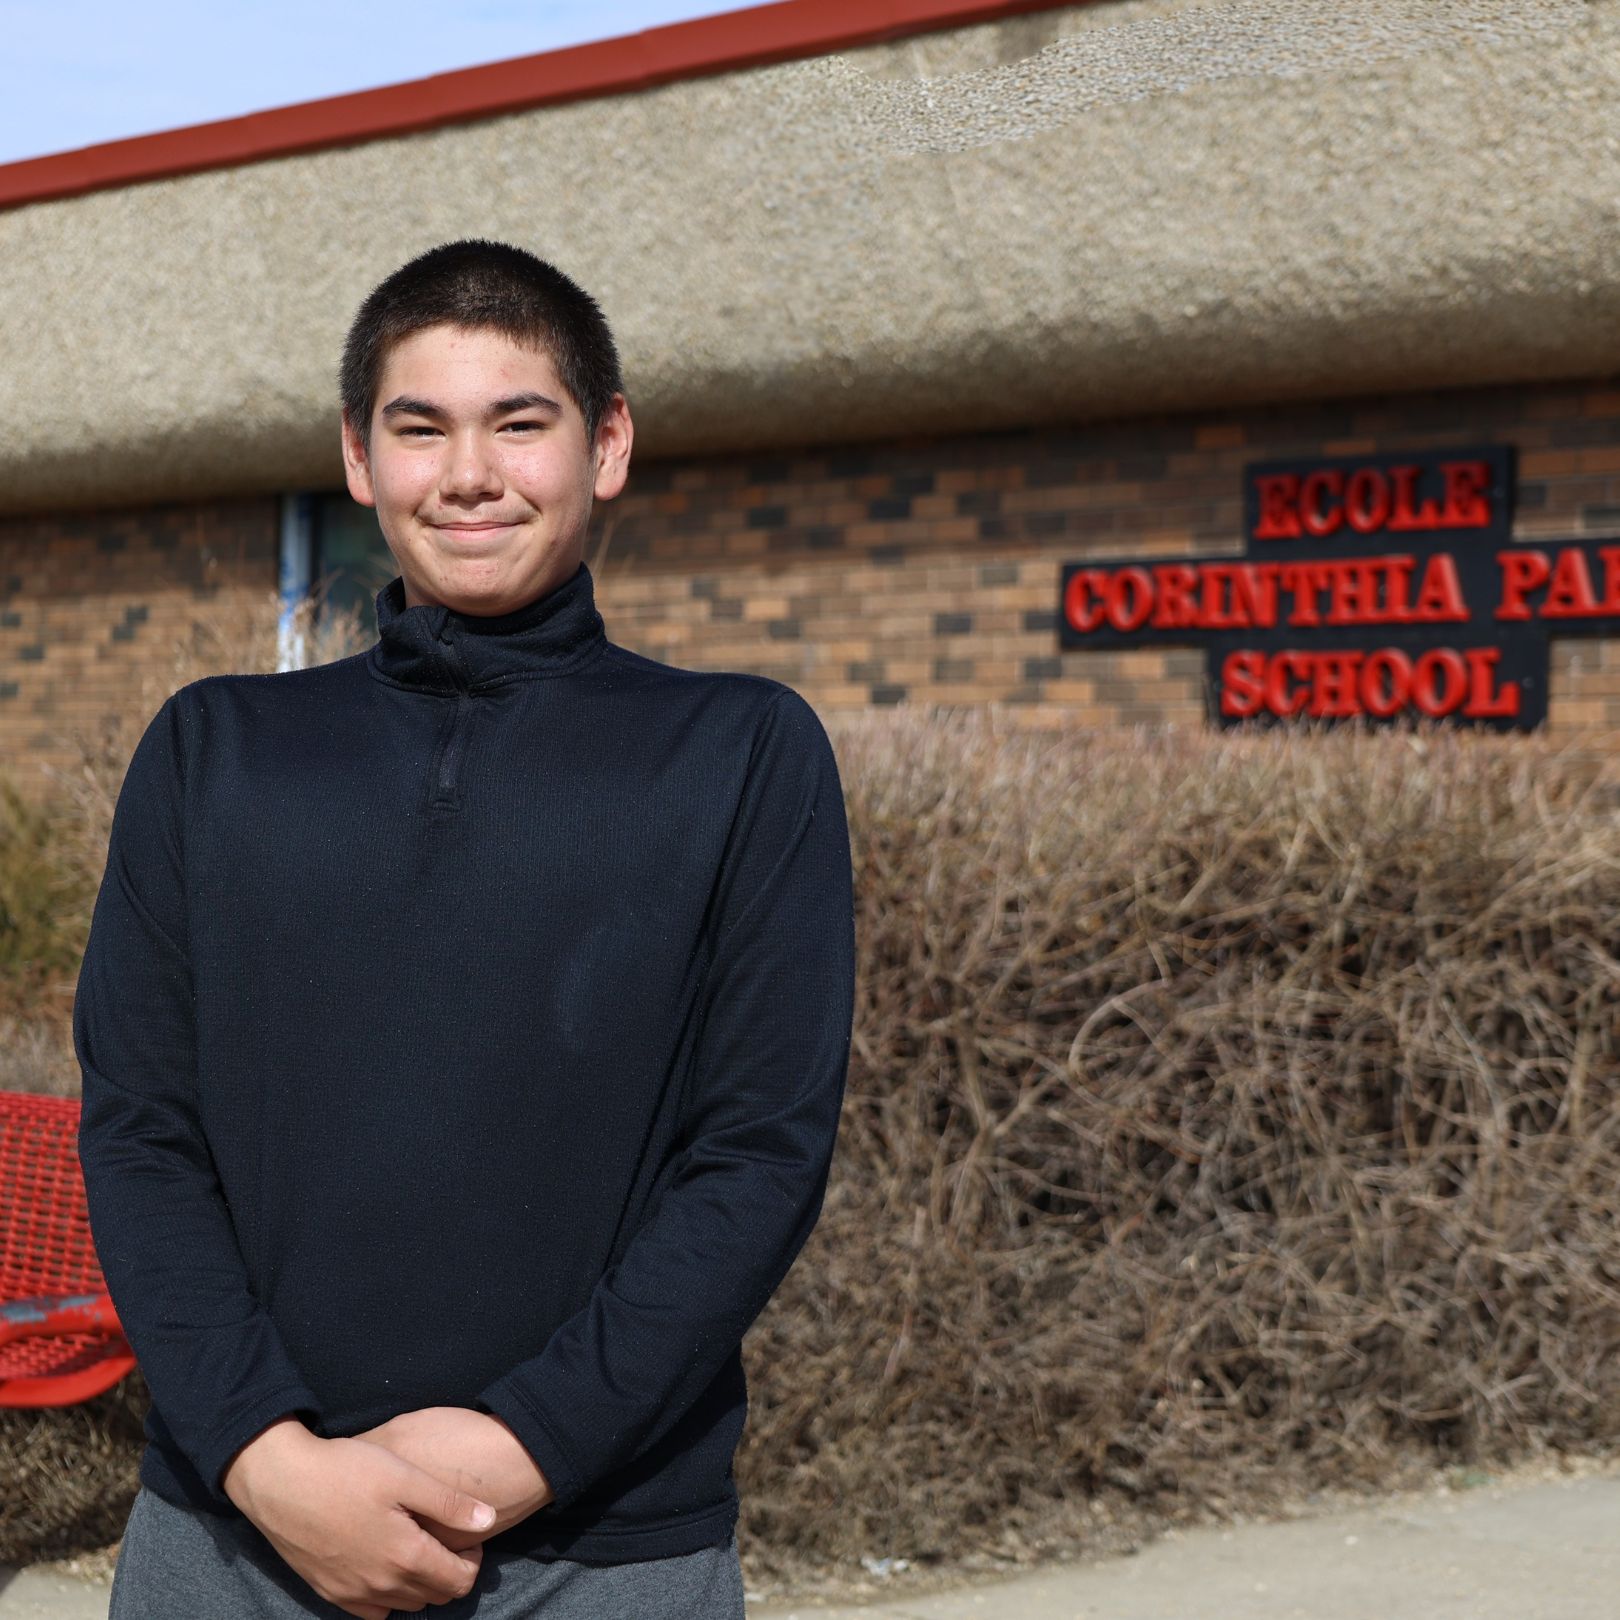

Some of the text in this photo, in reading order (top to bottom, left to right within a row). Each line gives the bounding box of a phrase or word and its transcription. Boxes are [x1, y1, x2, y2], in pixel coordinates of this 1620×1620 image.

[1253, 461, 1490, 539] ECOLE
[1064, 553, 1470, 631] CORINTHIA
[1221, 647, 1519, 717] SCHOOL
